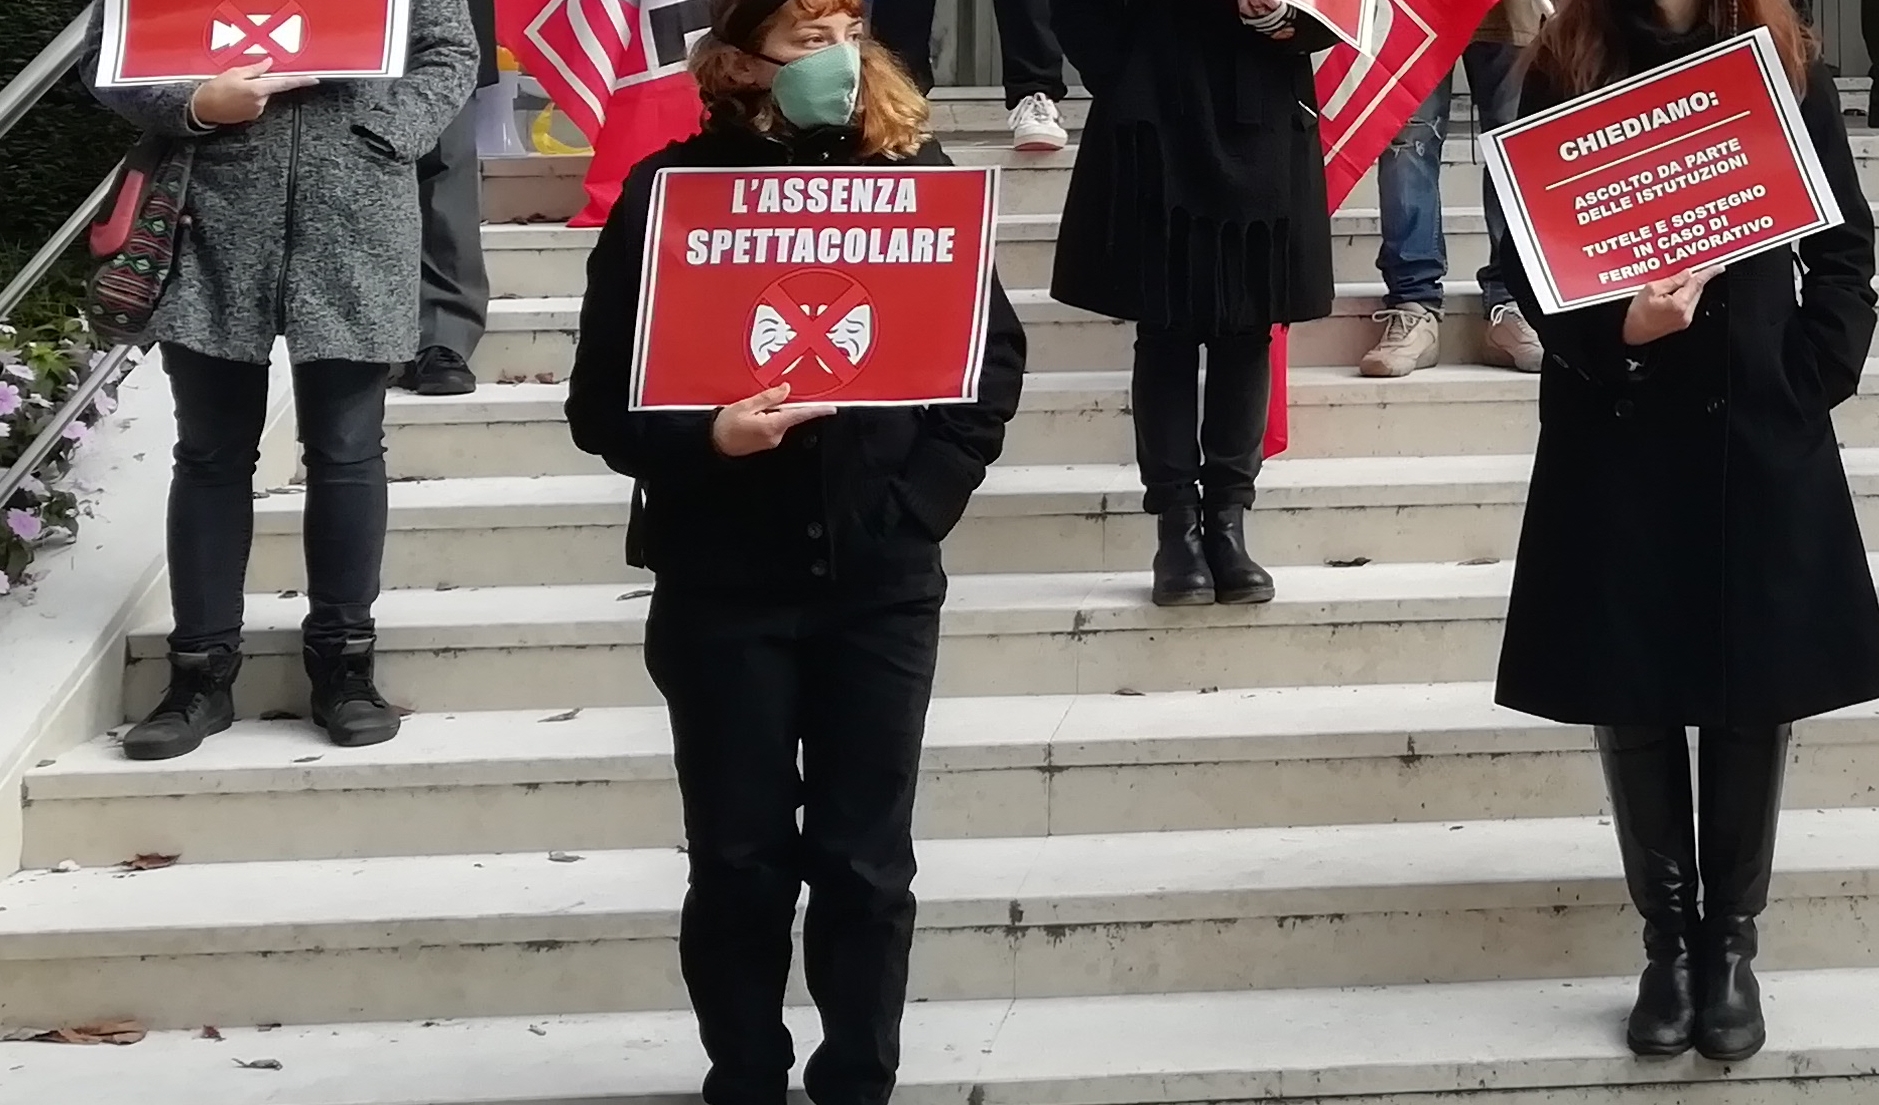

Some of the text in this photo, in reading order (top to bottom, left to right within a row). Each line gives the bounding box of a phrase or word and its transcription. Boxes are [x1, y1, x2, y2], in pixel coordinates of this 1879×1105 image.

[1558, 91, 1719, 162] CHIEDIAMO:
[731, 177, 917, 214] L'ASSENZA
[1574, 137, 1742, 210] ASCOLTO DA PARTE
[1576, 153, 1749, 226] DELLE ISTUTUZIONI
[685, 227, 956, 265] SPETTACOLARE
[1583, 184, 1767, 258] TUTELE E SOSTEGNO
[1599, 215, 1774, 285] FERMO LAVORATIVO
[1632, 214, 1729, 259] IN CASO DI
